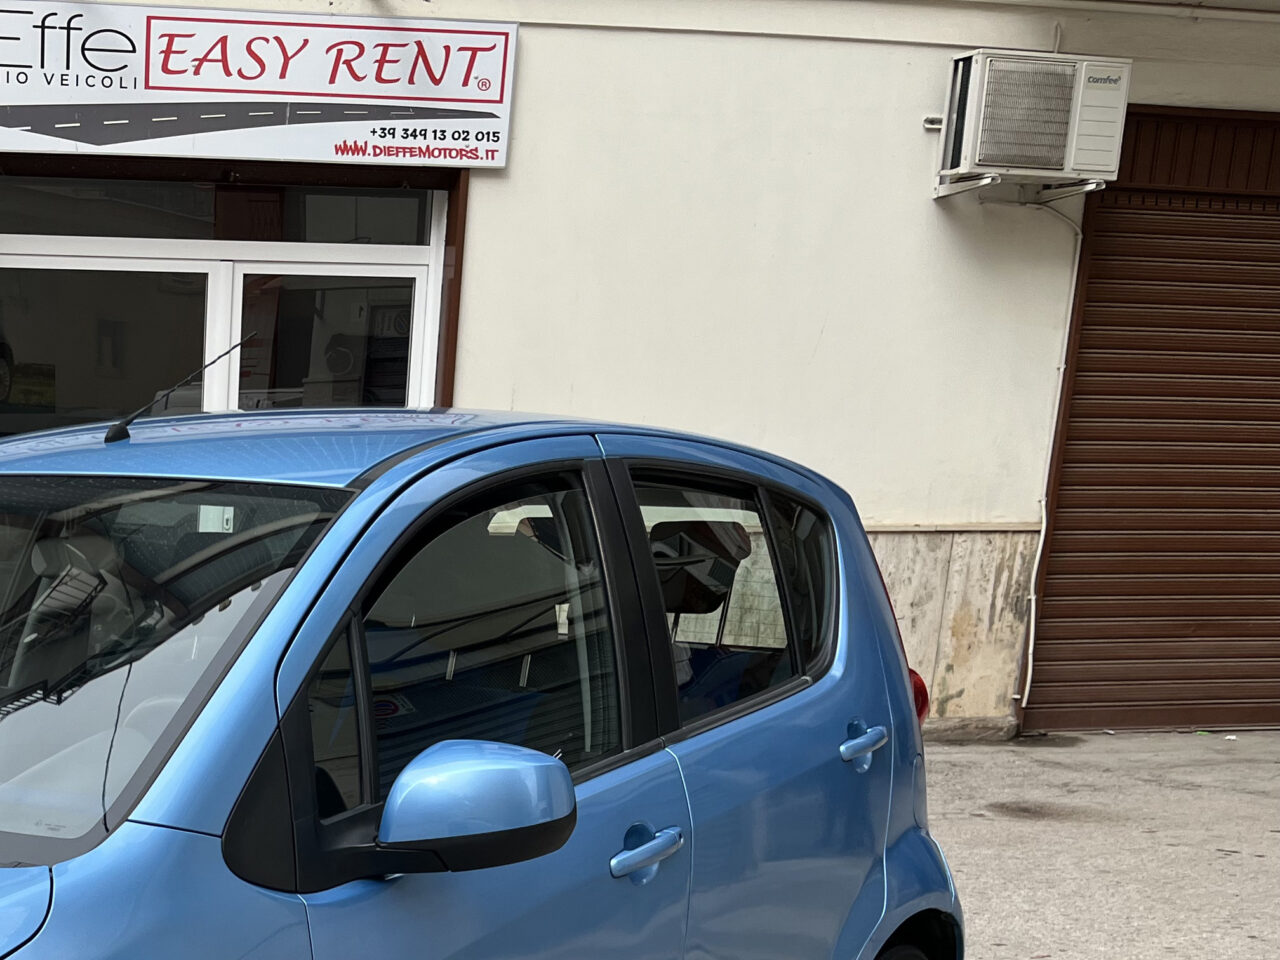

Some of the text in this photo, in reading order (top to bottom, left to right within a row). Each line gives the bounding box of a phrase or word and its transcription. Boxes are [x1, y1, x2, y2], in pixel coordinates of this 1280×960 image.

[158, 33, 310, 81] EASY
[43, 73, 137, 89] VEICOLI
[370, 127, 501, 142] +39 349 13 02 015
